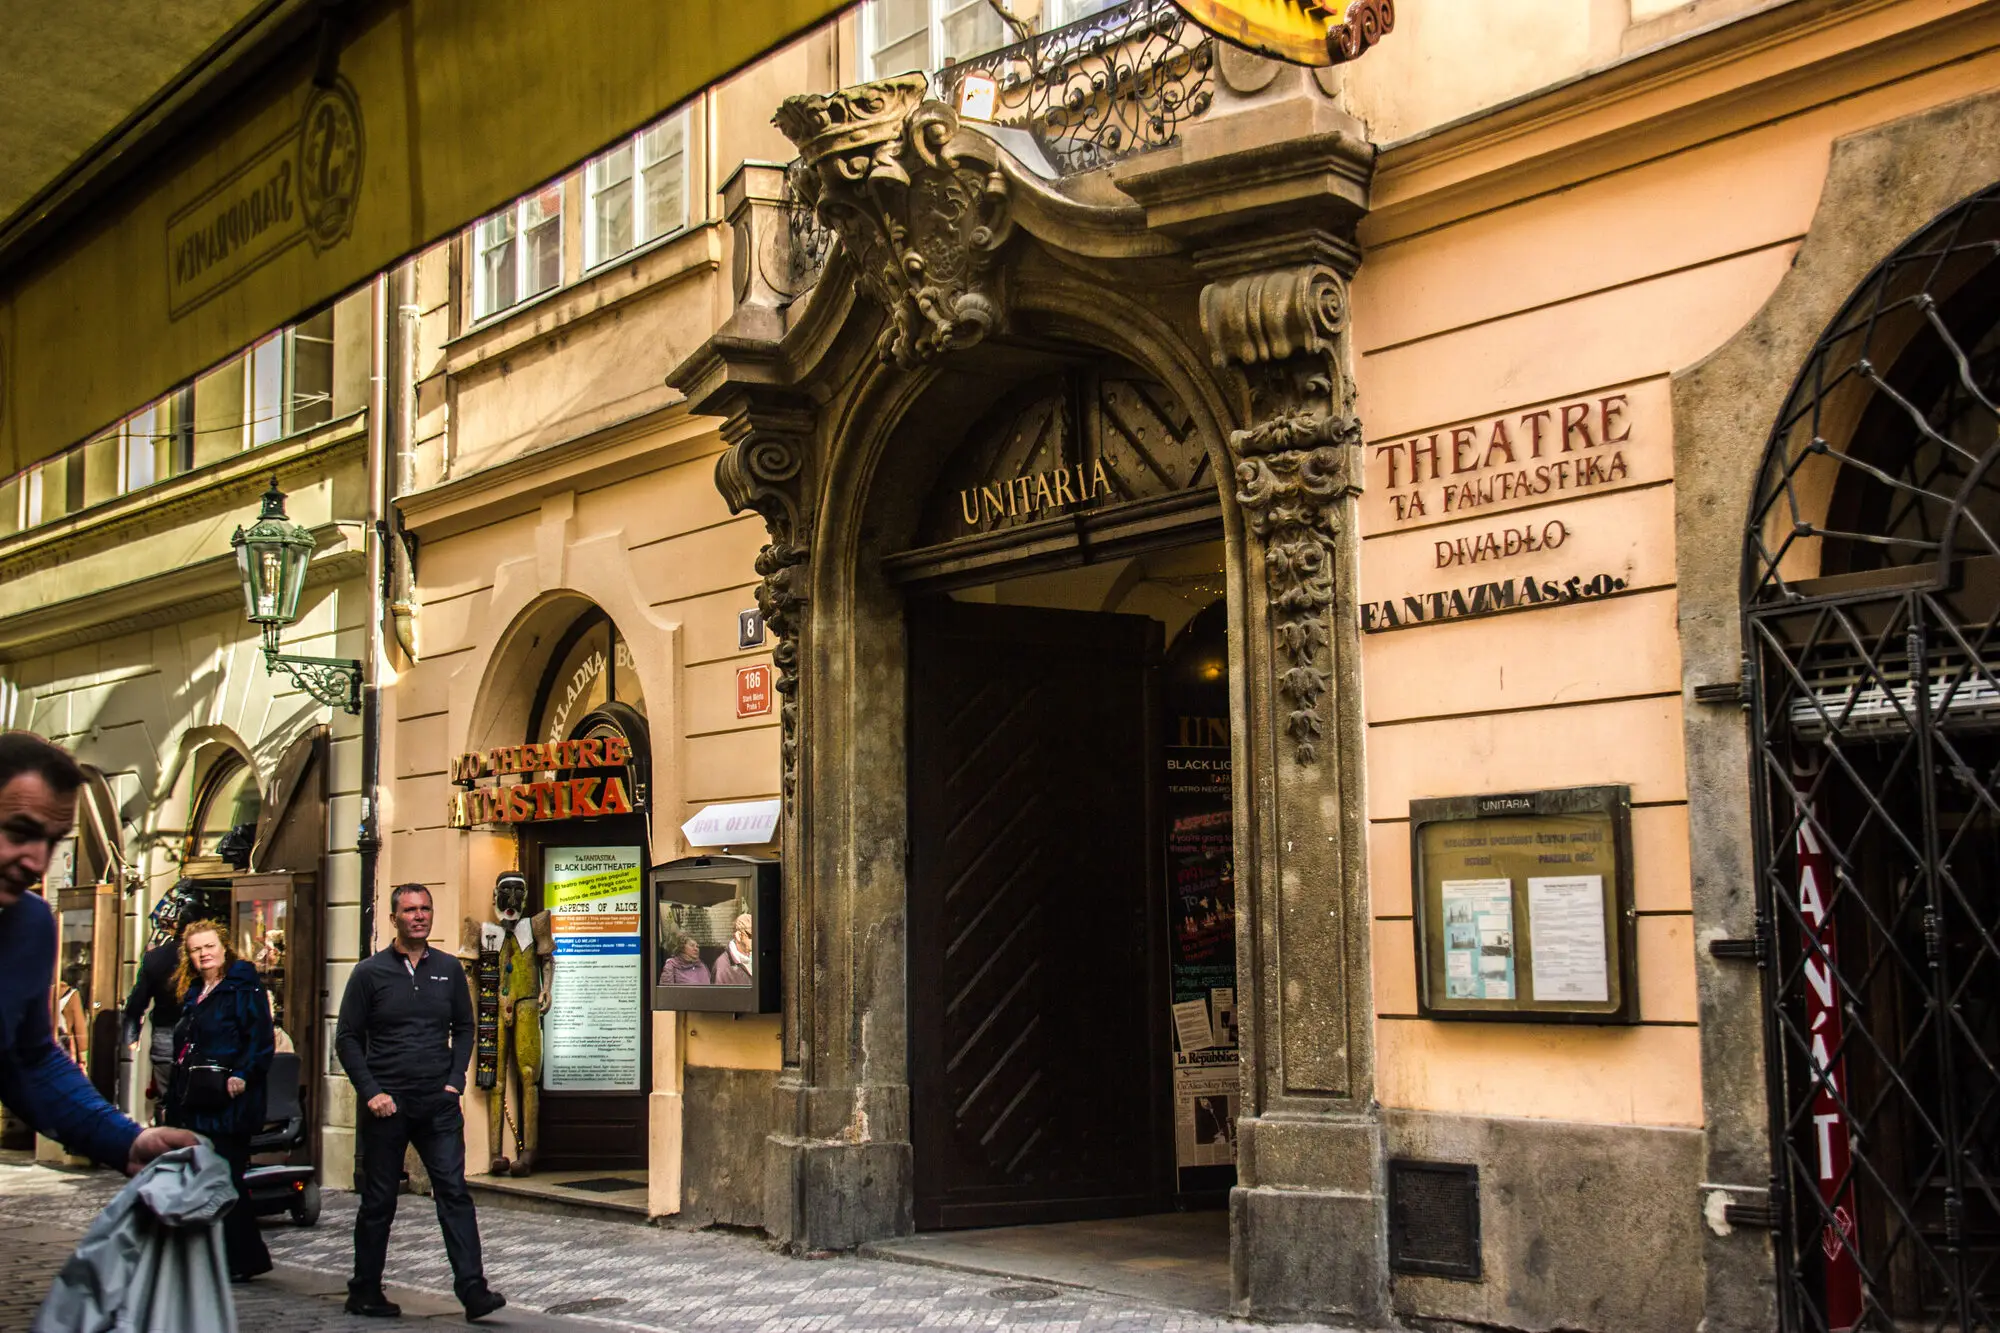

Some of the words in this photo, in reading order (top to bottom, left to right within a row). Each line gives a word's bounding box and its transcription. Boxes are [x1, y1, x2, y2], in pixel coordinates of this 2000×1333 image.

[1375, 394, 1633, 489] THEATRE
[960, 457, 1113, 525] UNITARIA
[1389, 490, 1427, 521] TA
[1442, 451, 1628, 513] FANTASTIKA
[1434, 520, 1567, 569] DIVADLO
[1359, 575, 1542, 632] FANTAZMA
[746, 618, 755, 638] 8
[745, 671, 761, 690] 186
[490, 737, 628, 776] THEATRE
[1167, 760, 1210, 770] BLACK
[1168, 785, 1200, 793] TEATRO
[1201, 785, 1231, 793] NEGRO
[1482, 798, 1531, 811] UNITARIA
[692, 818, 720, 834] BOX
[725, 814, 773, 832] OFFICE
[554, 863, 579, 872] BLACK
[580, 863, 603, 872] LIGHT
[603, 862, 637, 871] THEATRE
[578, 878, 595, 886] negro
[608, 871, 630, 880] popular
[598, 881, 614, 889] Praga
[559, 894, 581, 903] historia
[559, 903, 590, 913] ASPECTS
[597, 903, 608, 912] OF
[615, 902, 638, 912] ALICE
[1177, 1053, 1186, 1064] la
[1188, 1051, 1239, 1066] Repubblica
